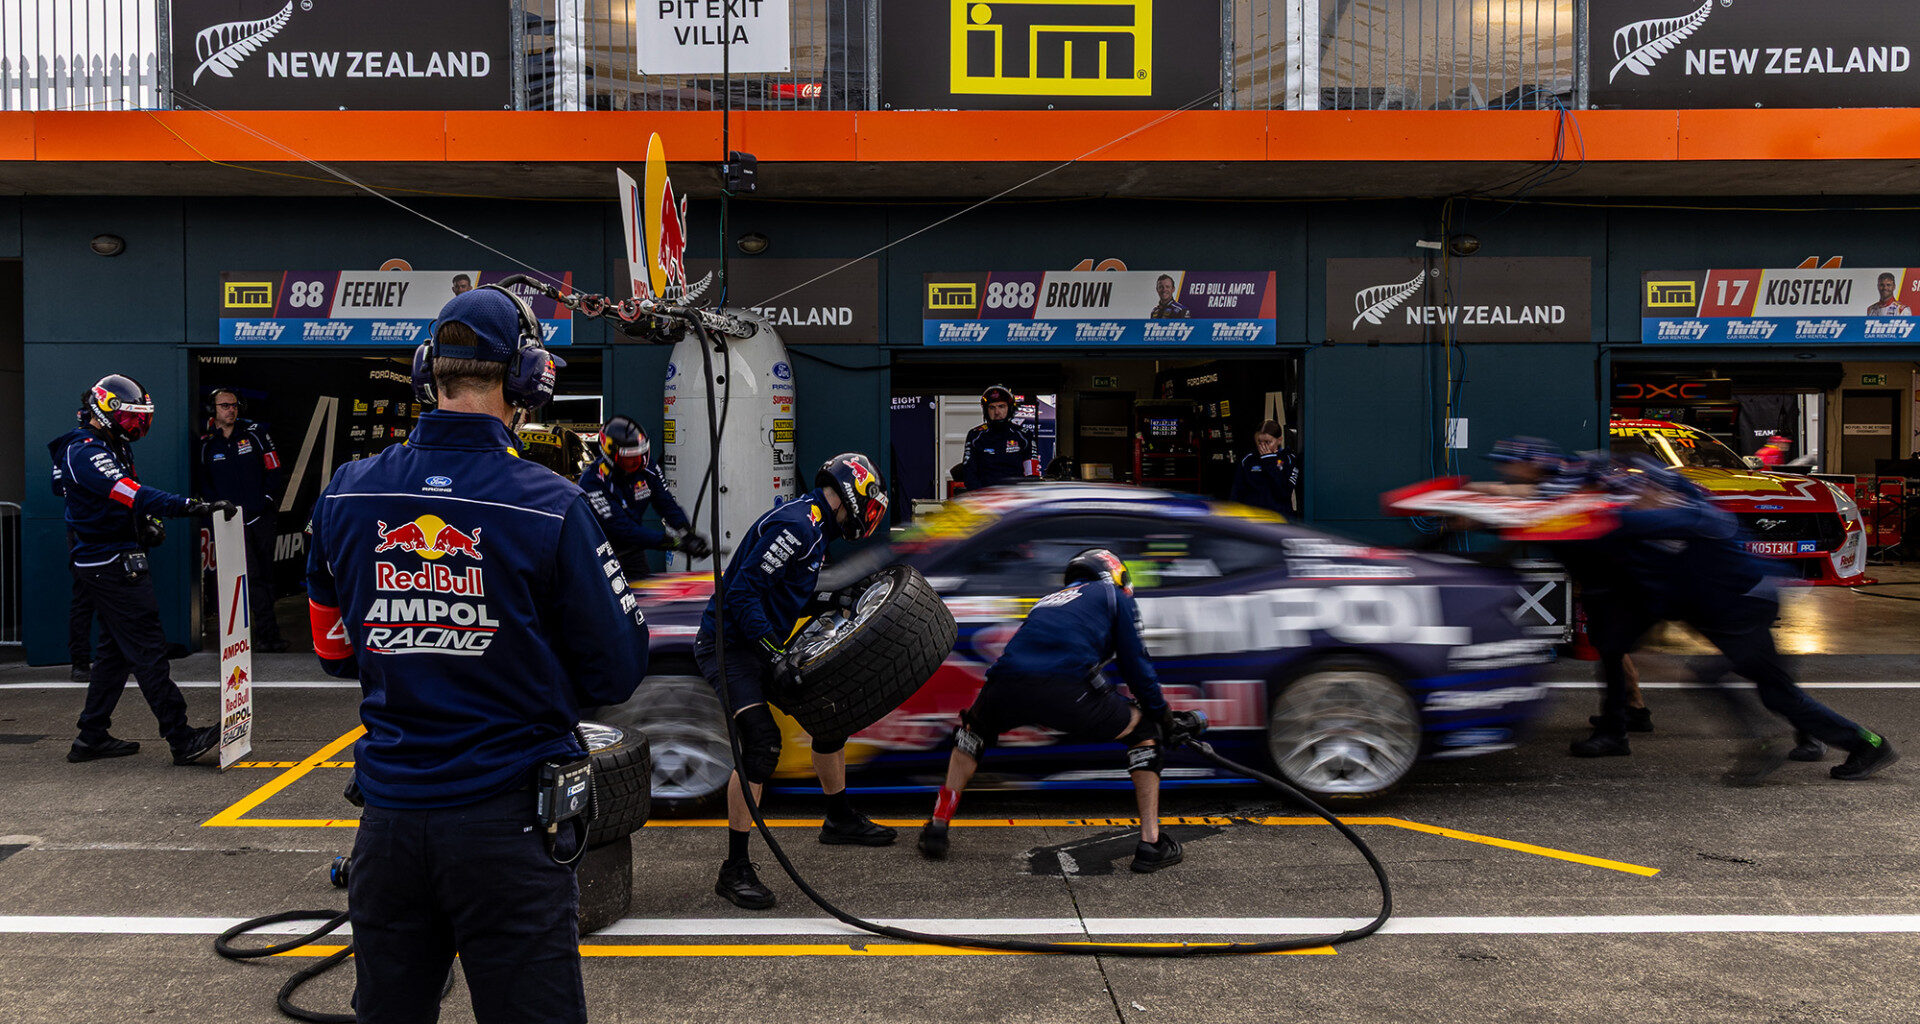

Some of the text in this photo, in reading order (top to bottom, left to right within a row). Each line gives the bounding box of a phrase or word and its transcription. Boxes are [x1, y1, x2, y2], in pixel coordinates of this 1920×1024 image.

[659, 0, 761, 19] PIT EXIT
[674, 25, 749, 45] VILLA
[268, 52, 490, 78] NEW ZEALAND
[1686, 47, 1910, 75] NEW ZEALAND
[289, 281, 325, 308] 88
[341, 281, 410, 307] FEENEY
[986, 282, 1035, 308] 888
[1045, 282, 1113, 308] BROWN
[1189, 283, 1204, 295] RED
[1206, 283, 1224, 295] BULL
[1226, 283, 1255, 296] AMPOL
[1208, 296, 1238, 308] RACING
[1717, 280, 1750, 306] 17
[1765, 279, 1852, 306] KOSTECKI
[1406, 306, 1566, 324] NEW ZEALAND
[234, 322, 422, 341] Thrifty Thrifty Thrifty
[938, 323, 1262, 342] Thrifty Thrifty Thrifty Thrifty Thrifty
[1658, 320, 1916, 339] Thrifty Thrifty Thrifty Thrifty
[892, 396, 922, 404] EIGHT
[376, 562, 484, 597] Red Bull
[364, 598, 499, 627] AMPOL
[222, 639, 250, 662] AMPOL
[366, 628, 494, 650] RACING
[224, 706, 250, 732] AMPOL
[222, 721, 250, 745] RACING
